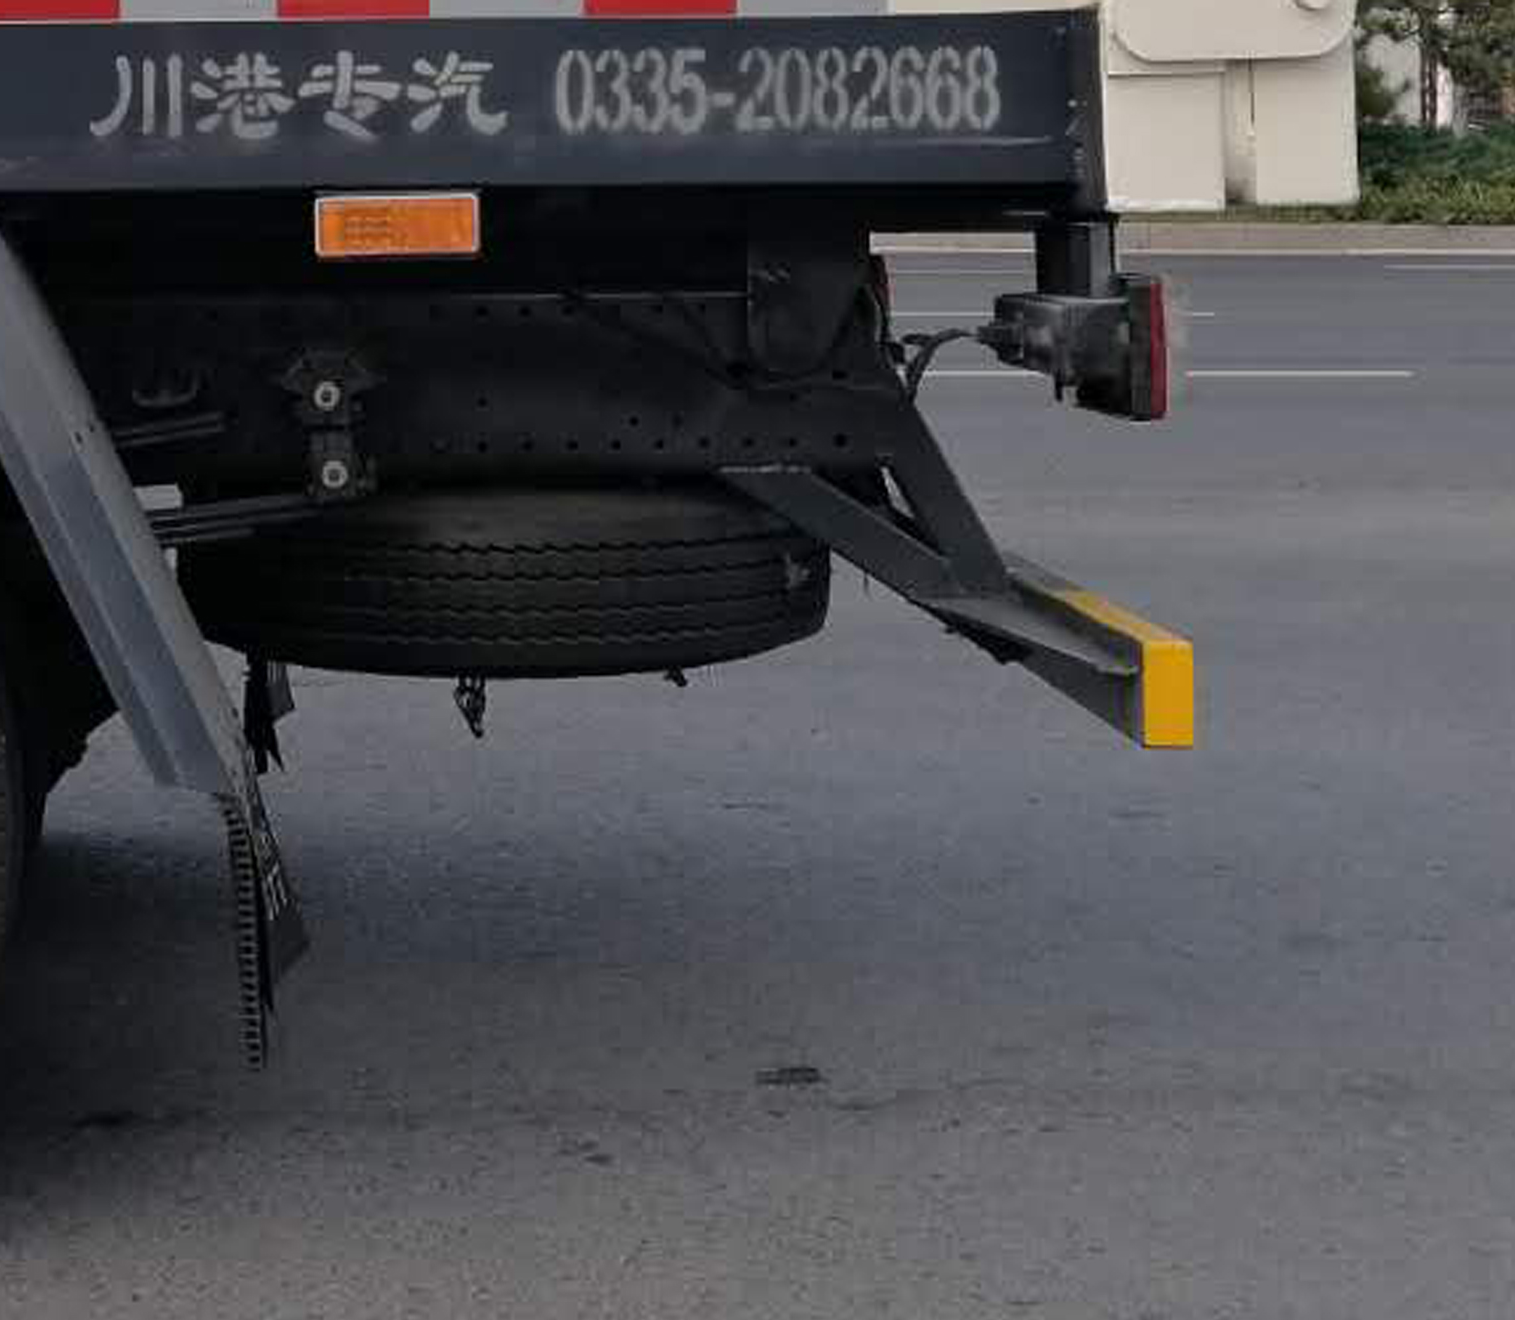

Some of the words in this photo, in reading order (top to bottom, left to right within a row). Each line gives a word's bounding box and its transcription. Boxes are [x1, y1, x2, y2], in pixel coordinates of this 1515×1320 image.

[89, 50, 509, 140] 川港专汽
[555, 46, 1001, 134] 0335-2082668
